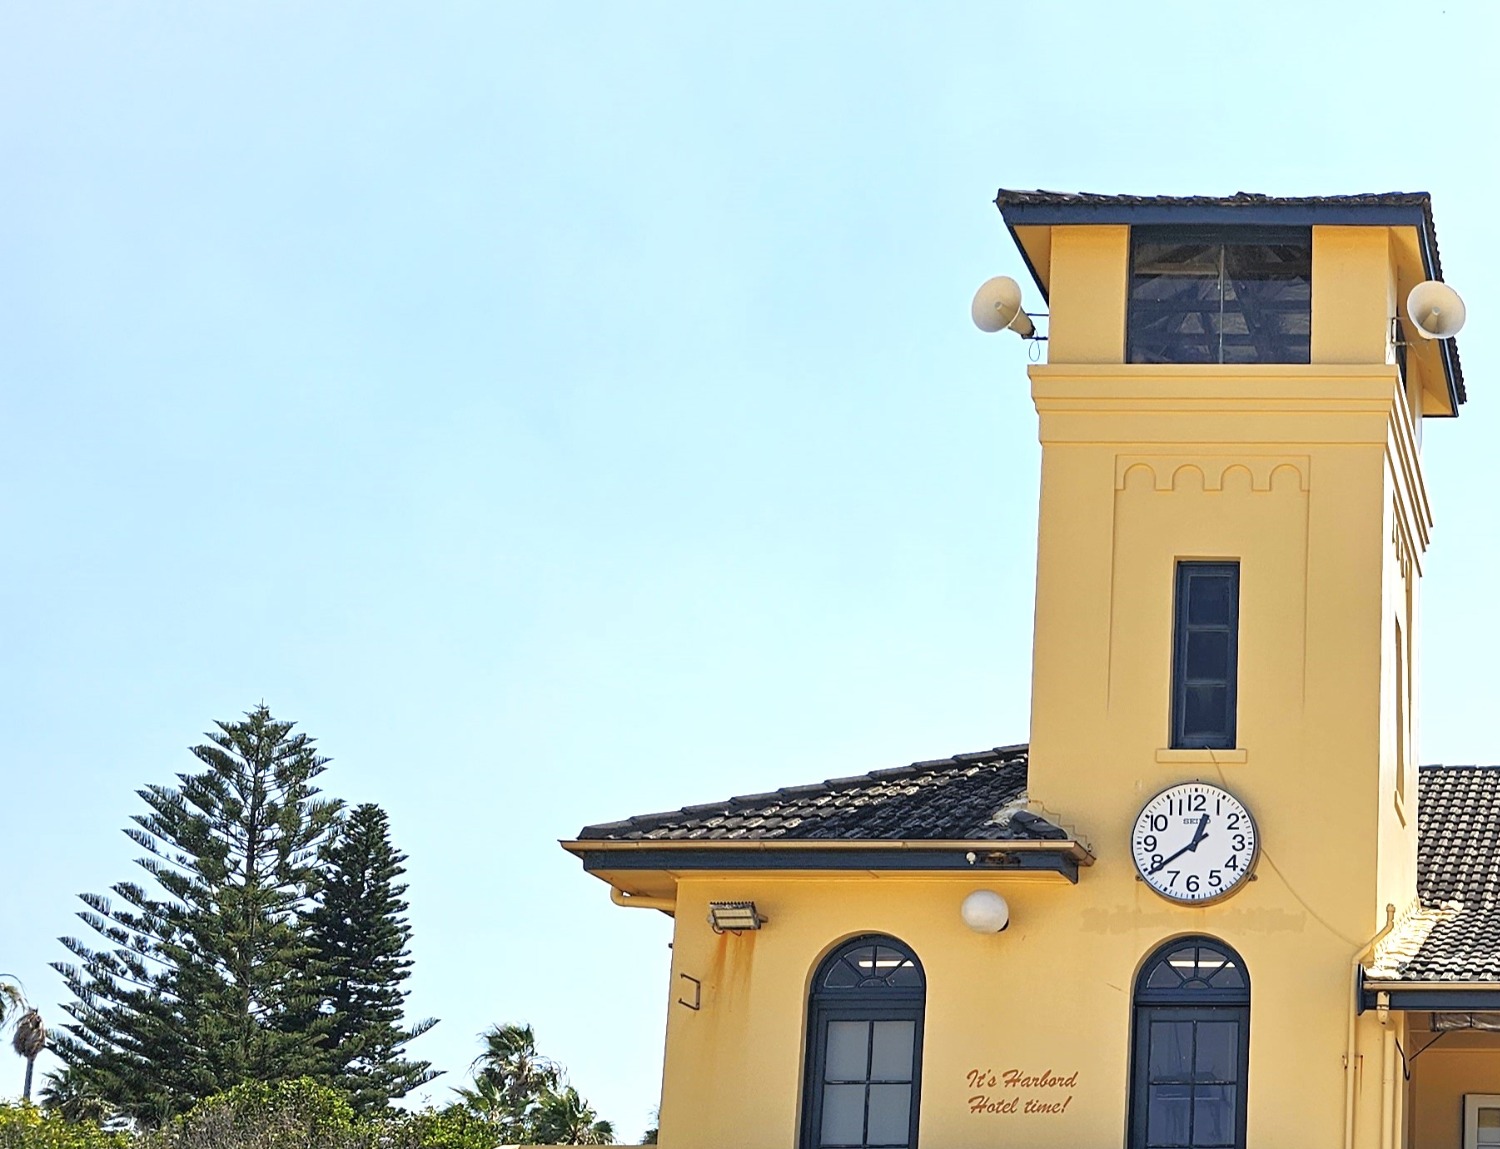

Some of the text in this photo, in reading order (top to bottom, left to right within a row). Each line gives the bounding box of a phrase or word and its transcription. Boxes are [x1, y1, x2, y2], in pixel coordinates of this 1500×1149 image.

[1169, 799, 1182, 816] 11
[1188, 794, 1206, 812] 12
[1216, 799, 1220, 816] 1
[1150, 814, 1168, 832] 10
[1227, 813, 1240, 830] 2
[1143, 835, 1157, 852] 9
[1232, 834, 1246, 851] 3
[1225, 854, 1238, 871] 4
[1167, 870, 1180, 887] 7
[1186, 875, 1199, 892] 6
[1208, 870, 1222, 887] 5
[966, 1069, 1079, 1088] It's Harbord
[968, 1095, 1073, 1114] Hotel time!
